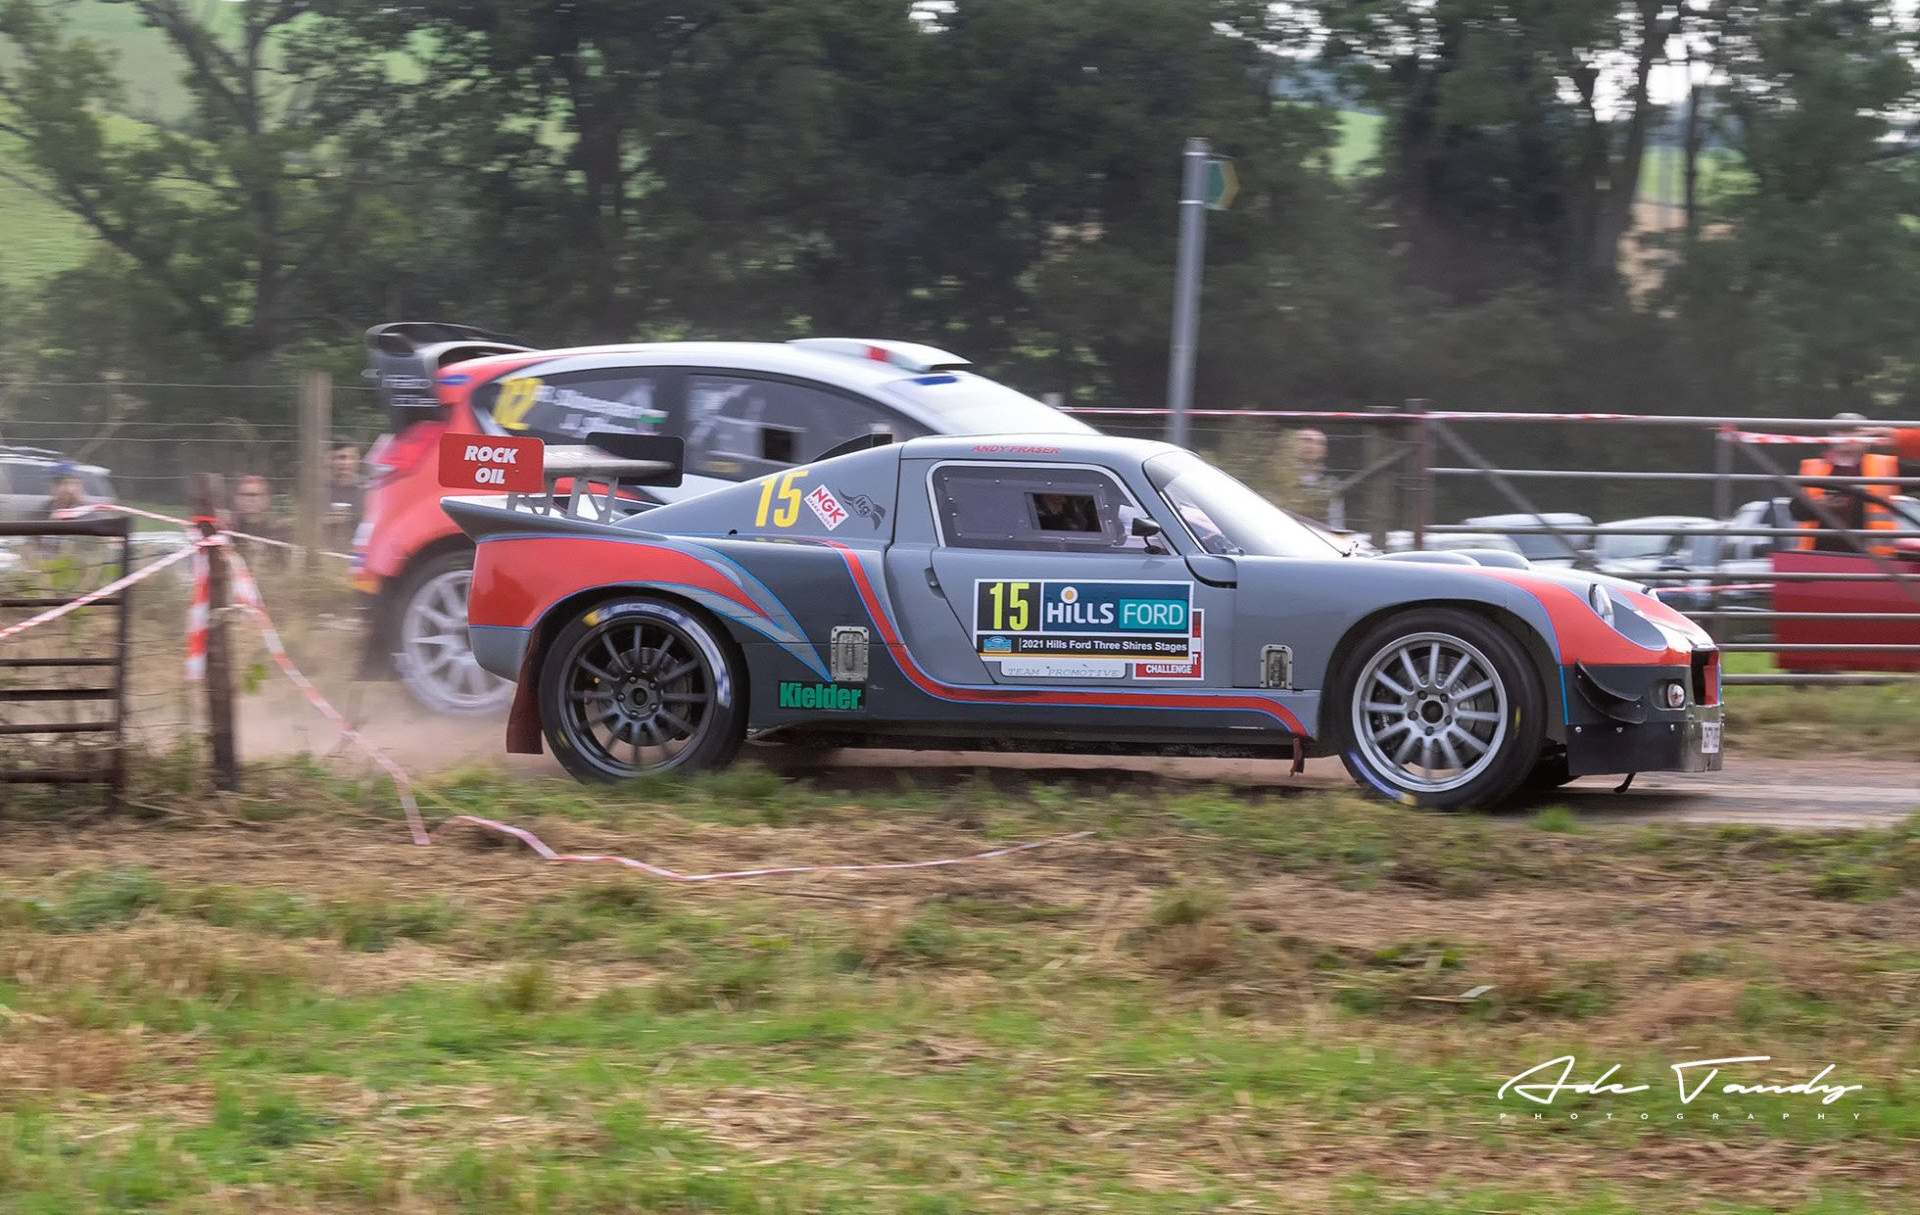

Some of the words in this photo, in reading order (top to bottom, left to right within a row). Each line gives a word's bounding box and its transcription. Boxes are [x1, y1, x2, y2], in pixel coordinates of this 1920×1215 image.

[463, 445, 519, 464] ROCK
[971, 444, 1007, 453] ANDY
[1009, 445, 1060, 454] FRASER
[475, 467, 506, 485] OIL
[755, 470, 809, 528] 15
[811, 487, 845, 524] NGK
[989, 582, 1031, 631] 15
[1123, 603, 1185, 626] FORD
[1022, 639, 1044, 649] 2021
[1046, 639, 1068, 650] Hills
[1069, 640, 1092, 650] Ford
[1094, 640, 1121, 651] Three
[1122, 641, 1153, 651] Shires
[1154, 641, 1188, 653] Stages
[1007, 668, 1040, 676] TEAM
[1047, 668, 1121, 677] PROMOTIVE
[1145, 664, 1193, 674] CHALLENGE
[780, 682, 862, 709] Kielder
